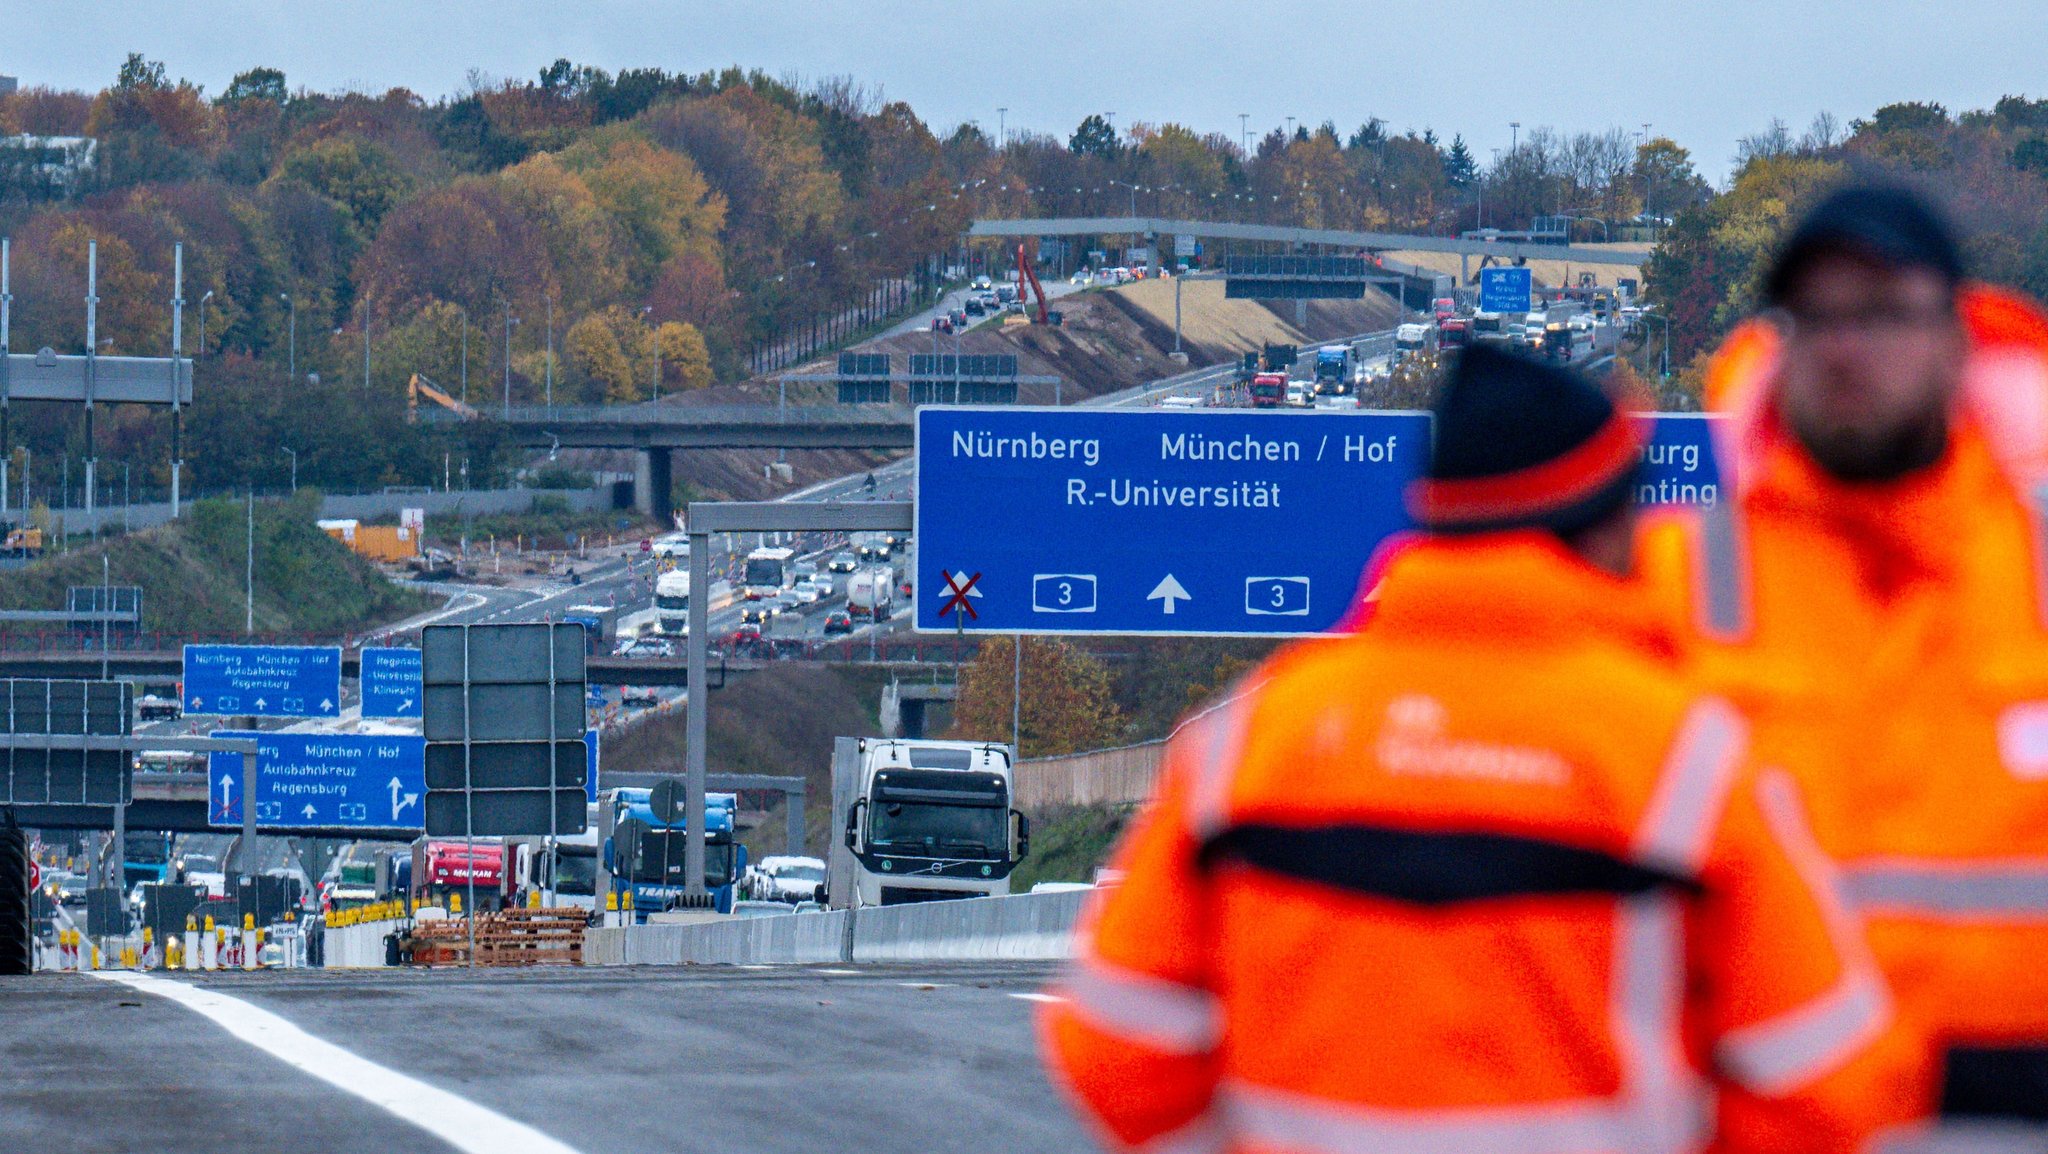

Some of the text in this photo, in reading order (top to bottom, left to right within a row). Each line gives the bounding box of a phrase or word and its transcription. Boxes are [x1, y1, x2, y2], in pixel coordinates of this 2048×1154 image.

[952, 431, 1397, 466] Nürnberg München / Hof
[1066, 479, 1281, 508] R.-Universität
[1058, 583, 1072, 605] 3
[1271, 585, 1285, 607] 3
[256, 653, 300, 665] München
[224, 665, 298, 677] Autobahnkreuz
[231, 679, 290, 690] Regensburg
[305, 744, 362, 758] München
[378, 745, 400, 758] Hof
[263, 763, 357, 777] Autobahnkreuz
[272, 781, 348, 797] Regensburg
